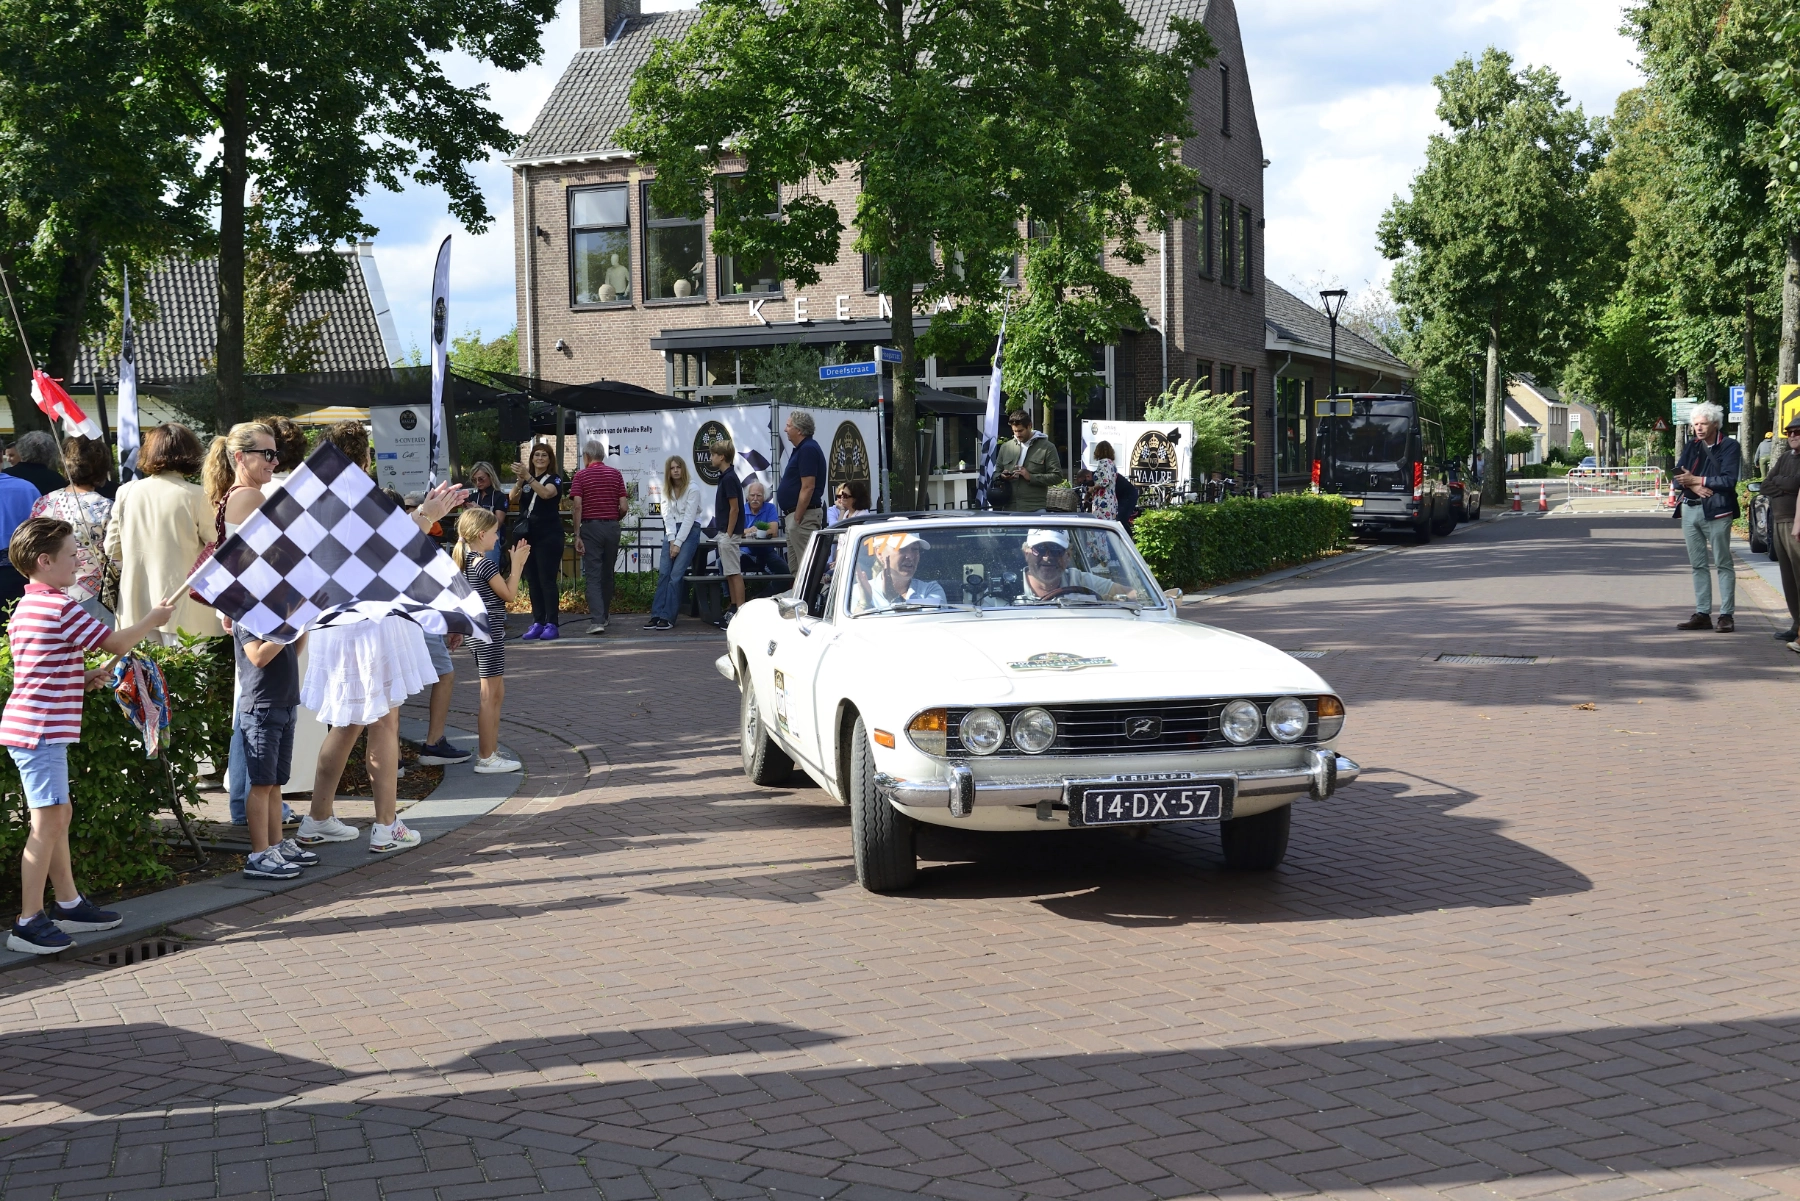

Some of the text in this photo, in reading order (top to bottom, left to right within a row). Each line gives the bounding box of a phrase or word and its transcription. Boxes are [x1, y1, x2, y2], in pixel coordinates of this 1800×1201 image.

[826, 366, 869, 376] Dreefstraat
[1733, 388, 1744, 403] P
[640, 425, 653, 434] Rally
[863, 532, 908, 557] 177
[1121, 773, 1189, 781] TRIUMPH
[1096, 790, 1212, 819] 14-DX-57
